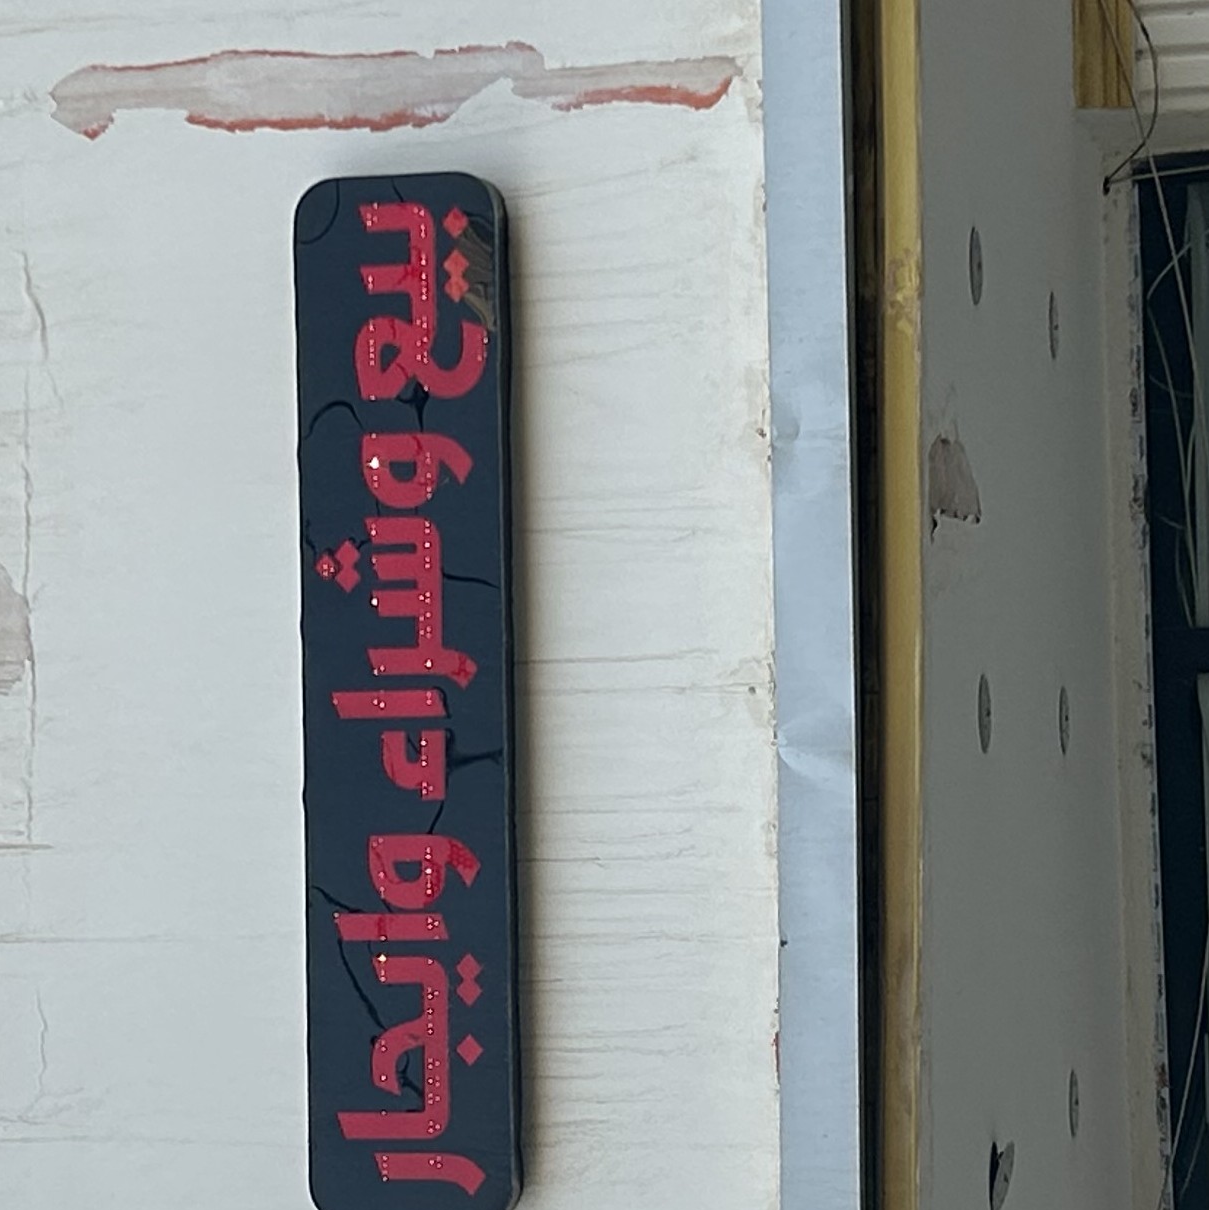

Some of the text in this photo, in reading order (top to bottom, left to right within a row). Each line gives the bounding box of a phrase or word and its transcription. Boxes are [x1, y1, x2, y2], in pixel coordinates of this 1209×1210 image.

[314, 201, 488, 1193] بيع وشراء وايجار
